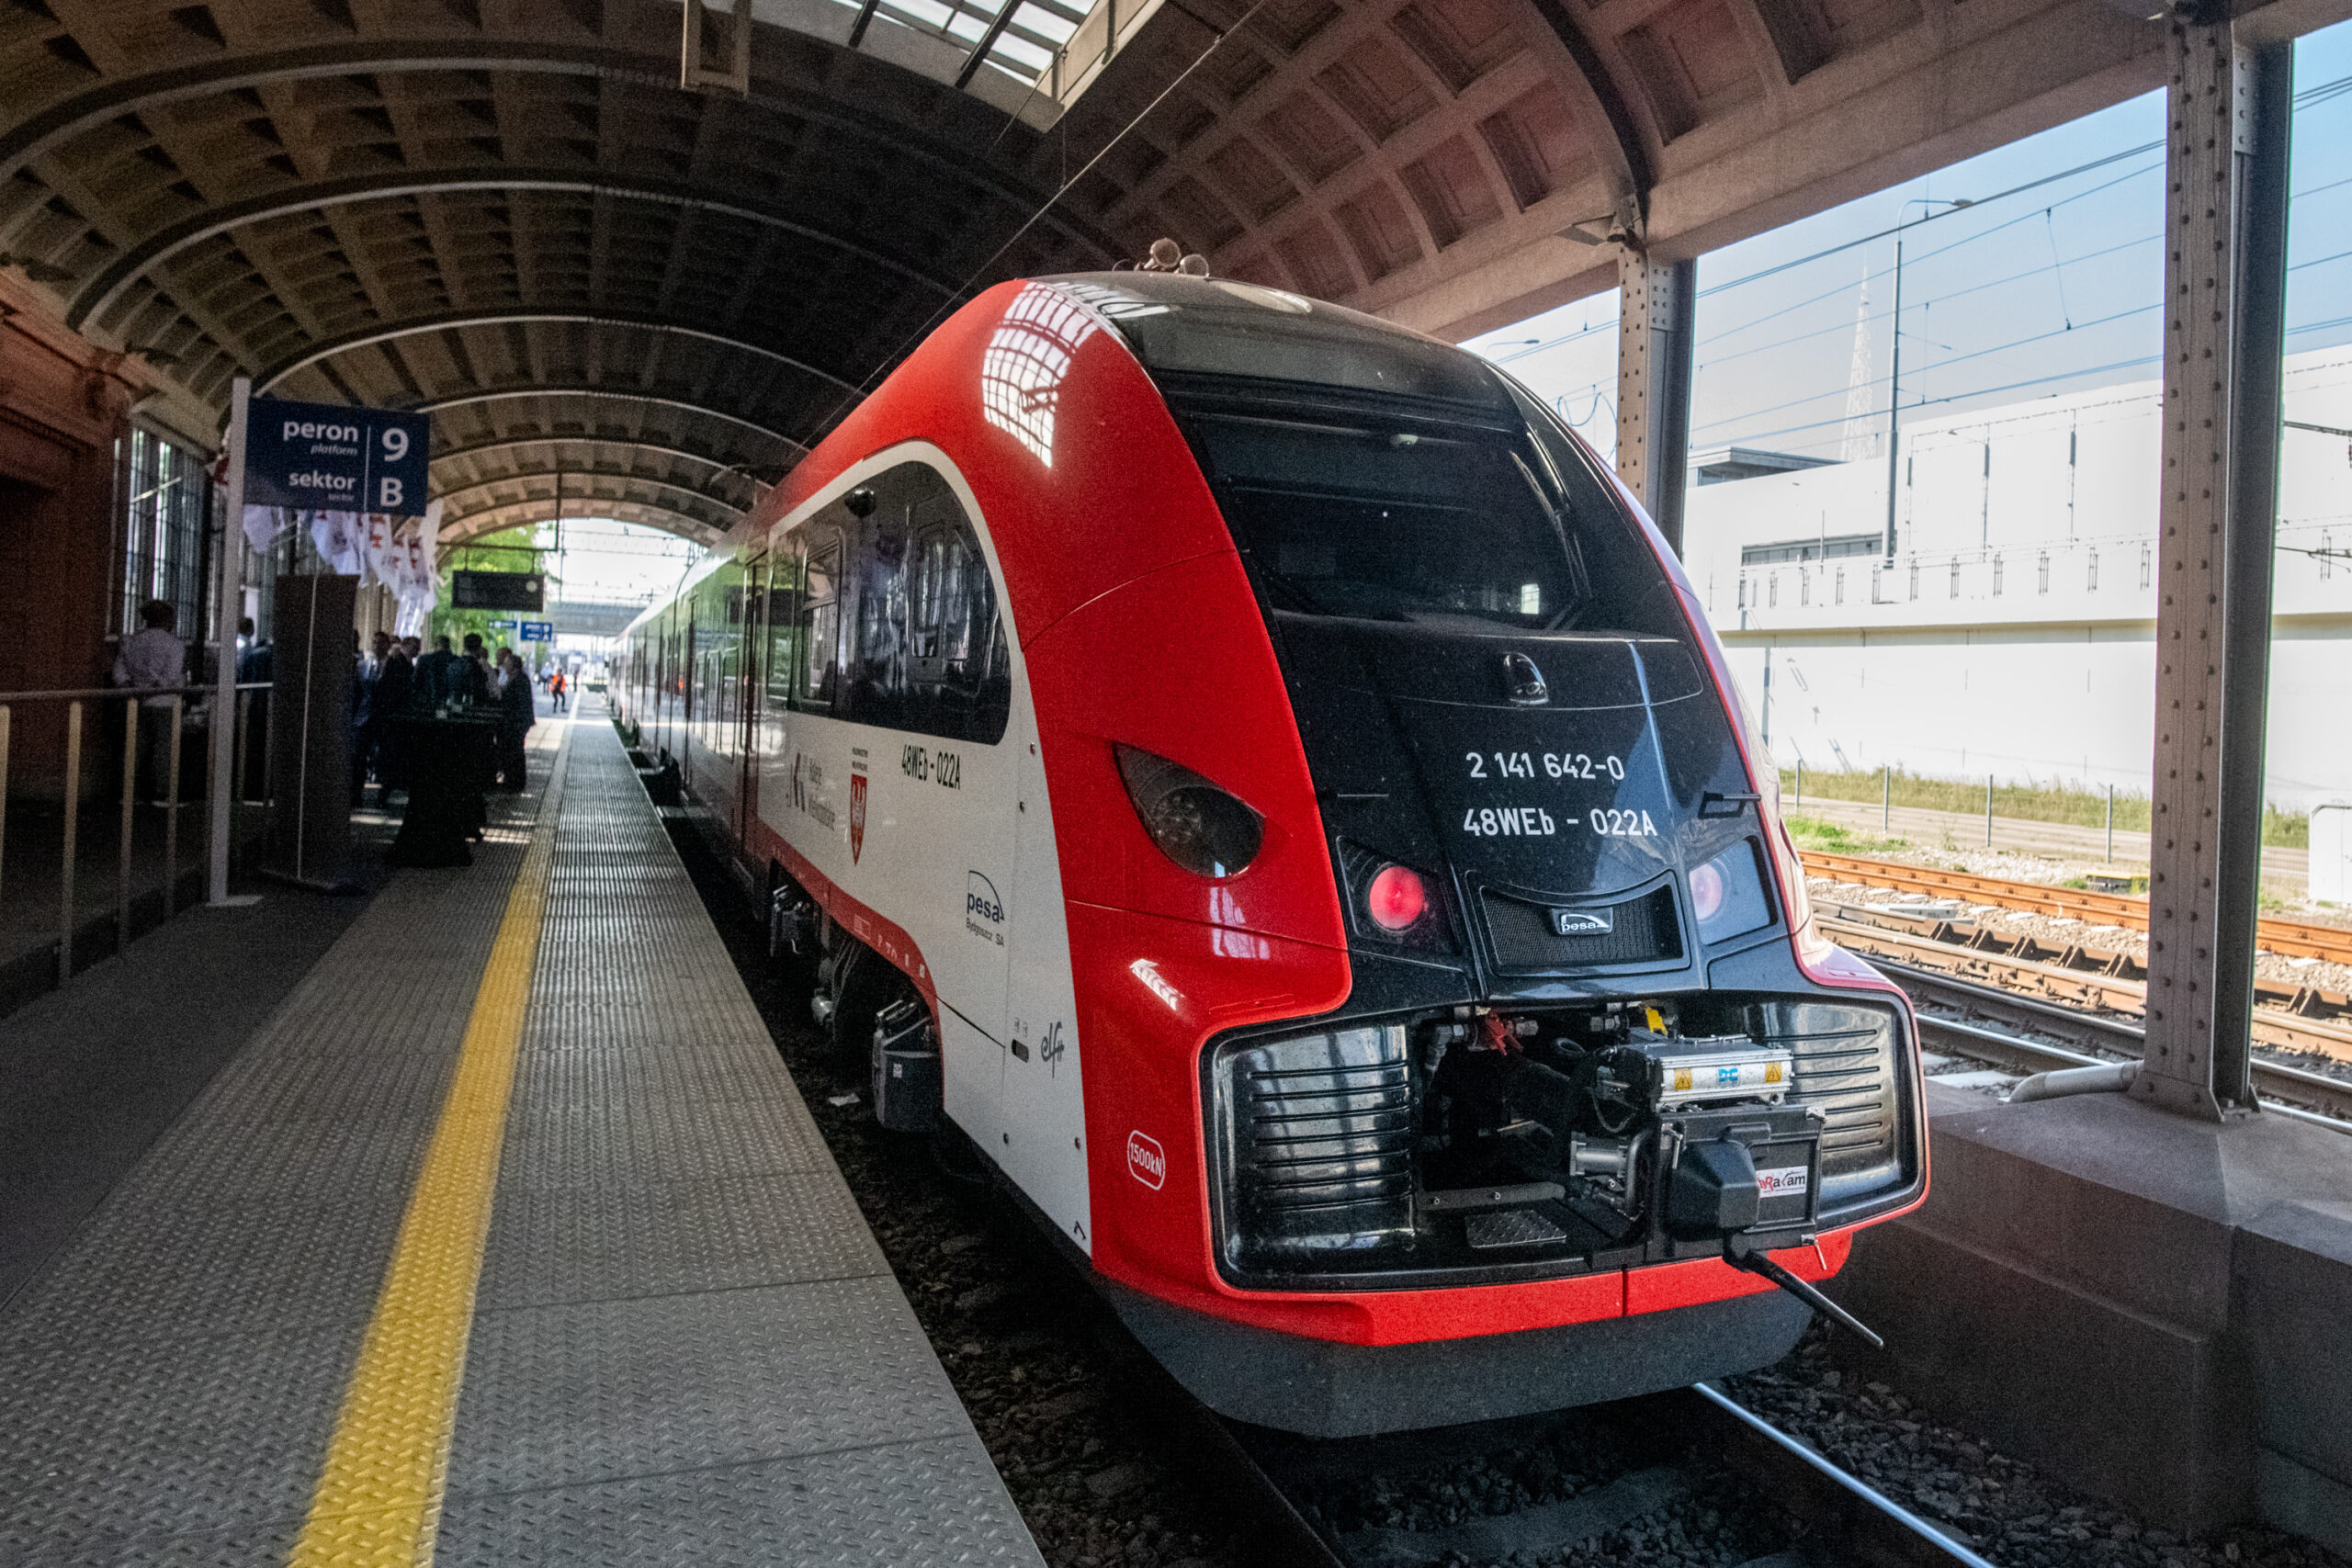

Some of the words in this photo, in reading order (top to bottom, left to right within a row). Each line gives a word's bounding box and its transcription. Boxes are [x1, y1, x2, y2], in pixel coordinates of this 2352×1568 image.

[283, 420, 358, 443] peron
[381, 427, 409, 462] 9
[311, 443, 357, 457] platform
[288, 469, 356, 491] sektor
[379, 477, 403, 507] B
[902, 743, 928, 782] 48WEb
[936, 750, 961, 790] 022A
[1465, 751, 1487, 778] 2
[1494, 751, 1535, 778] 141
[1543, 752, 1625, 780] 642-0
[1464, 807, 1555, 837] 48WEb
[1589, 808, 1658, 836] 022A
[967, 892, 1001, 924] pesa
[1561, 920, 1597, 933] pesa
[1130, 1142, 1162, 1178] 1500kN
